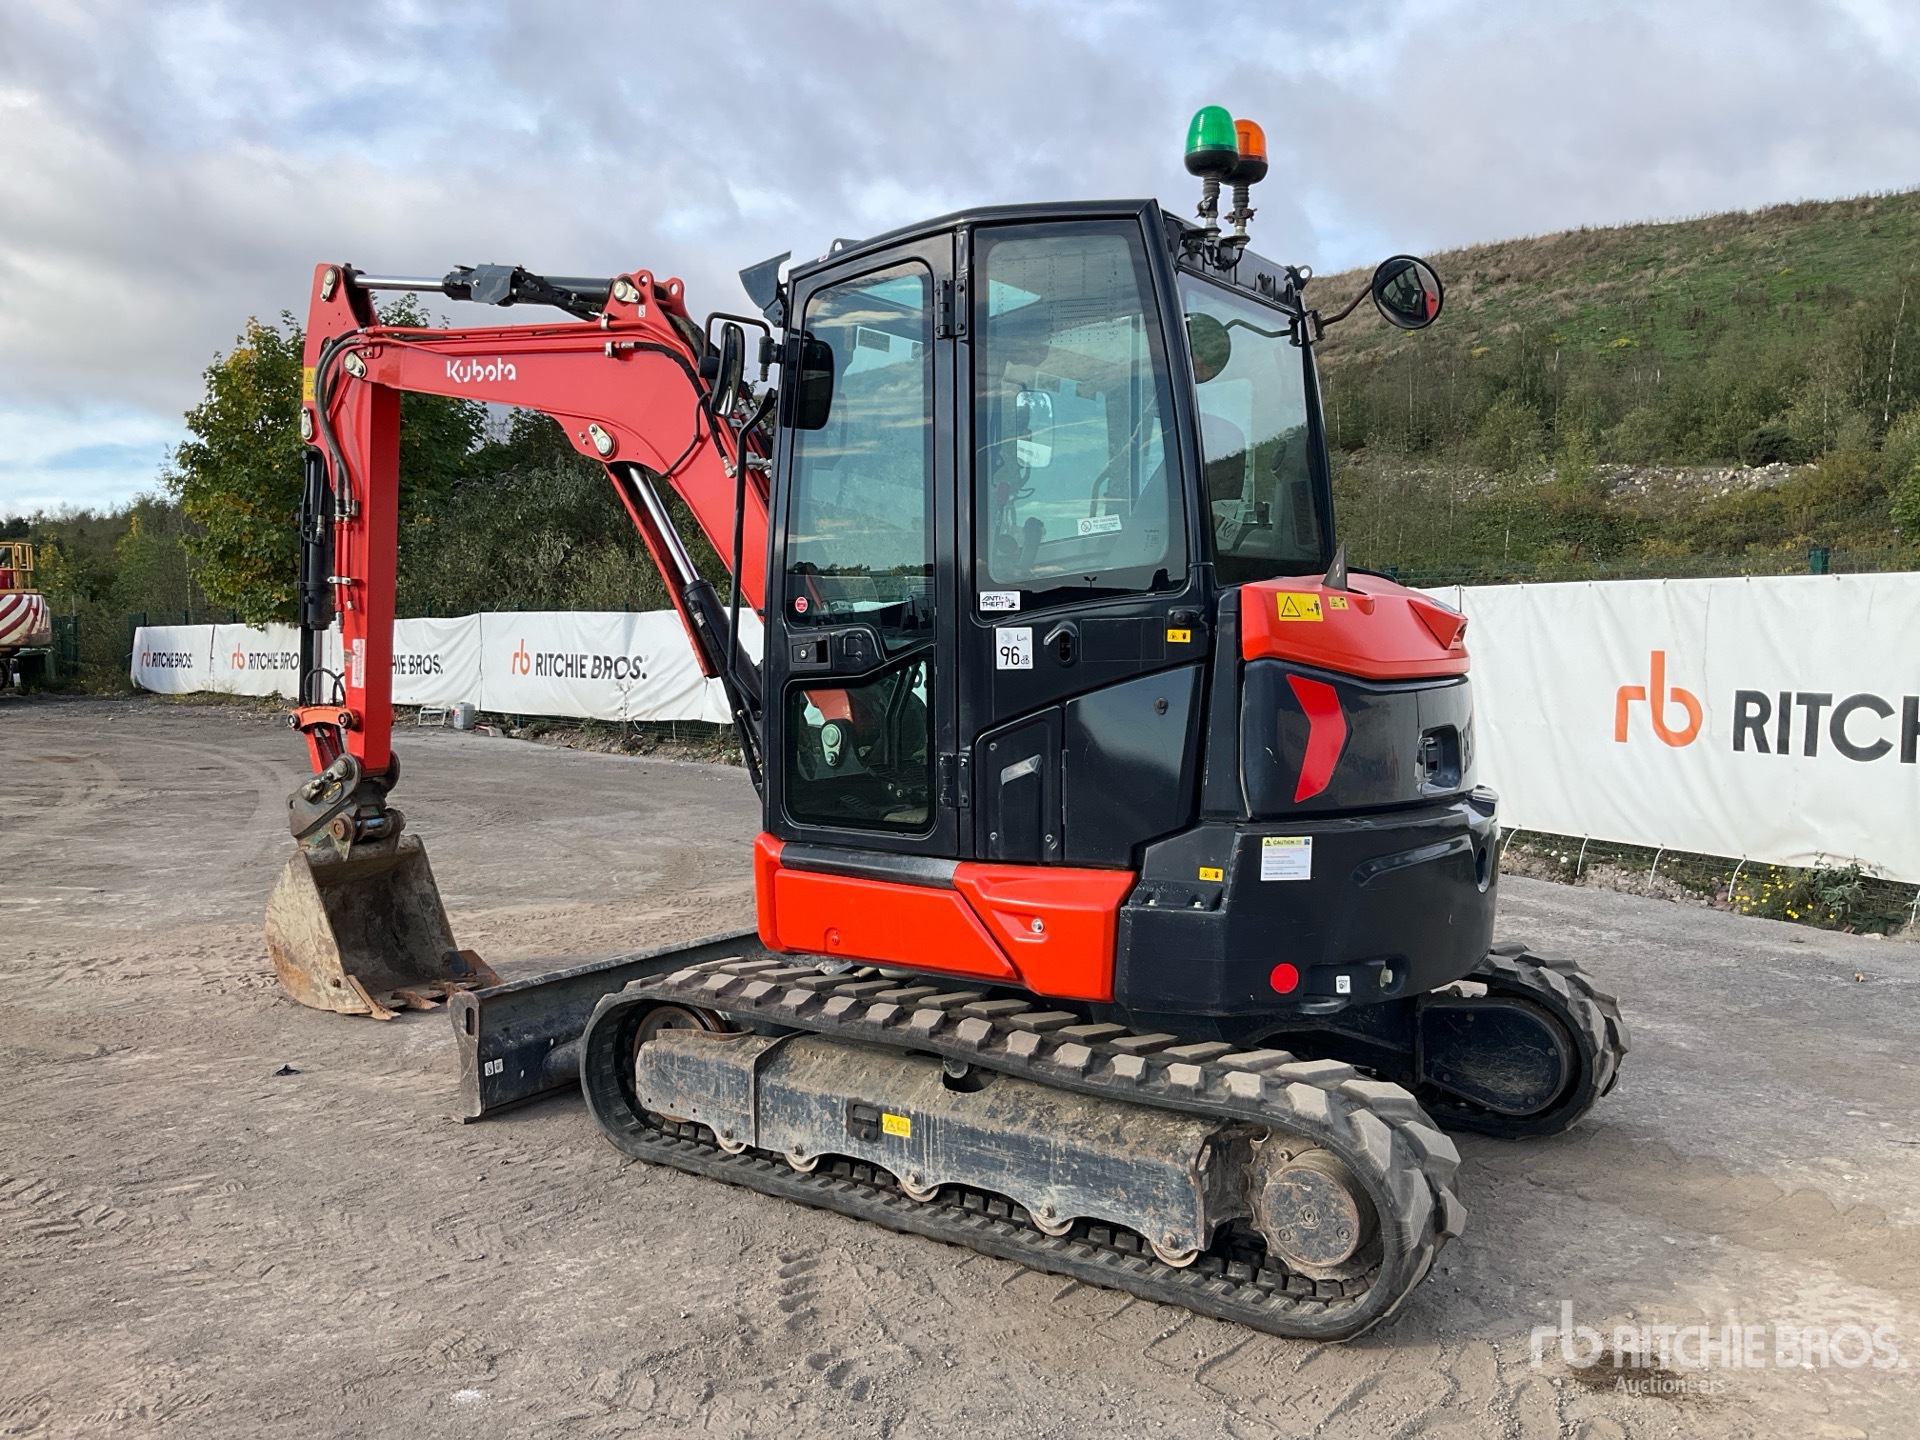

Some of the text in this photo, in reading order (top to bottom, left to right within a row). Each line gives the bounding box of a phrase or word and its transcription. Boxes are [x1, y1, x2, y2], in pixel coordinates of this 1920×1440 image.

[446, 357, 516, 383] Kubota
[151, 651, 174, 669] RITCHIE
[231, 642, 300, 670] rb RITCHIE BRO
[408, 653, 444, 675] BROS.
[511, 638, 648, 680] rb RITCHIE BROS.
[1000, 646, 1020, 665] 96
[1614, 649, 1704, 748] rb
